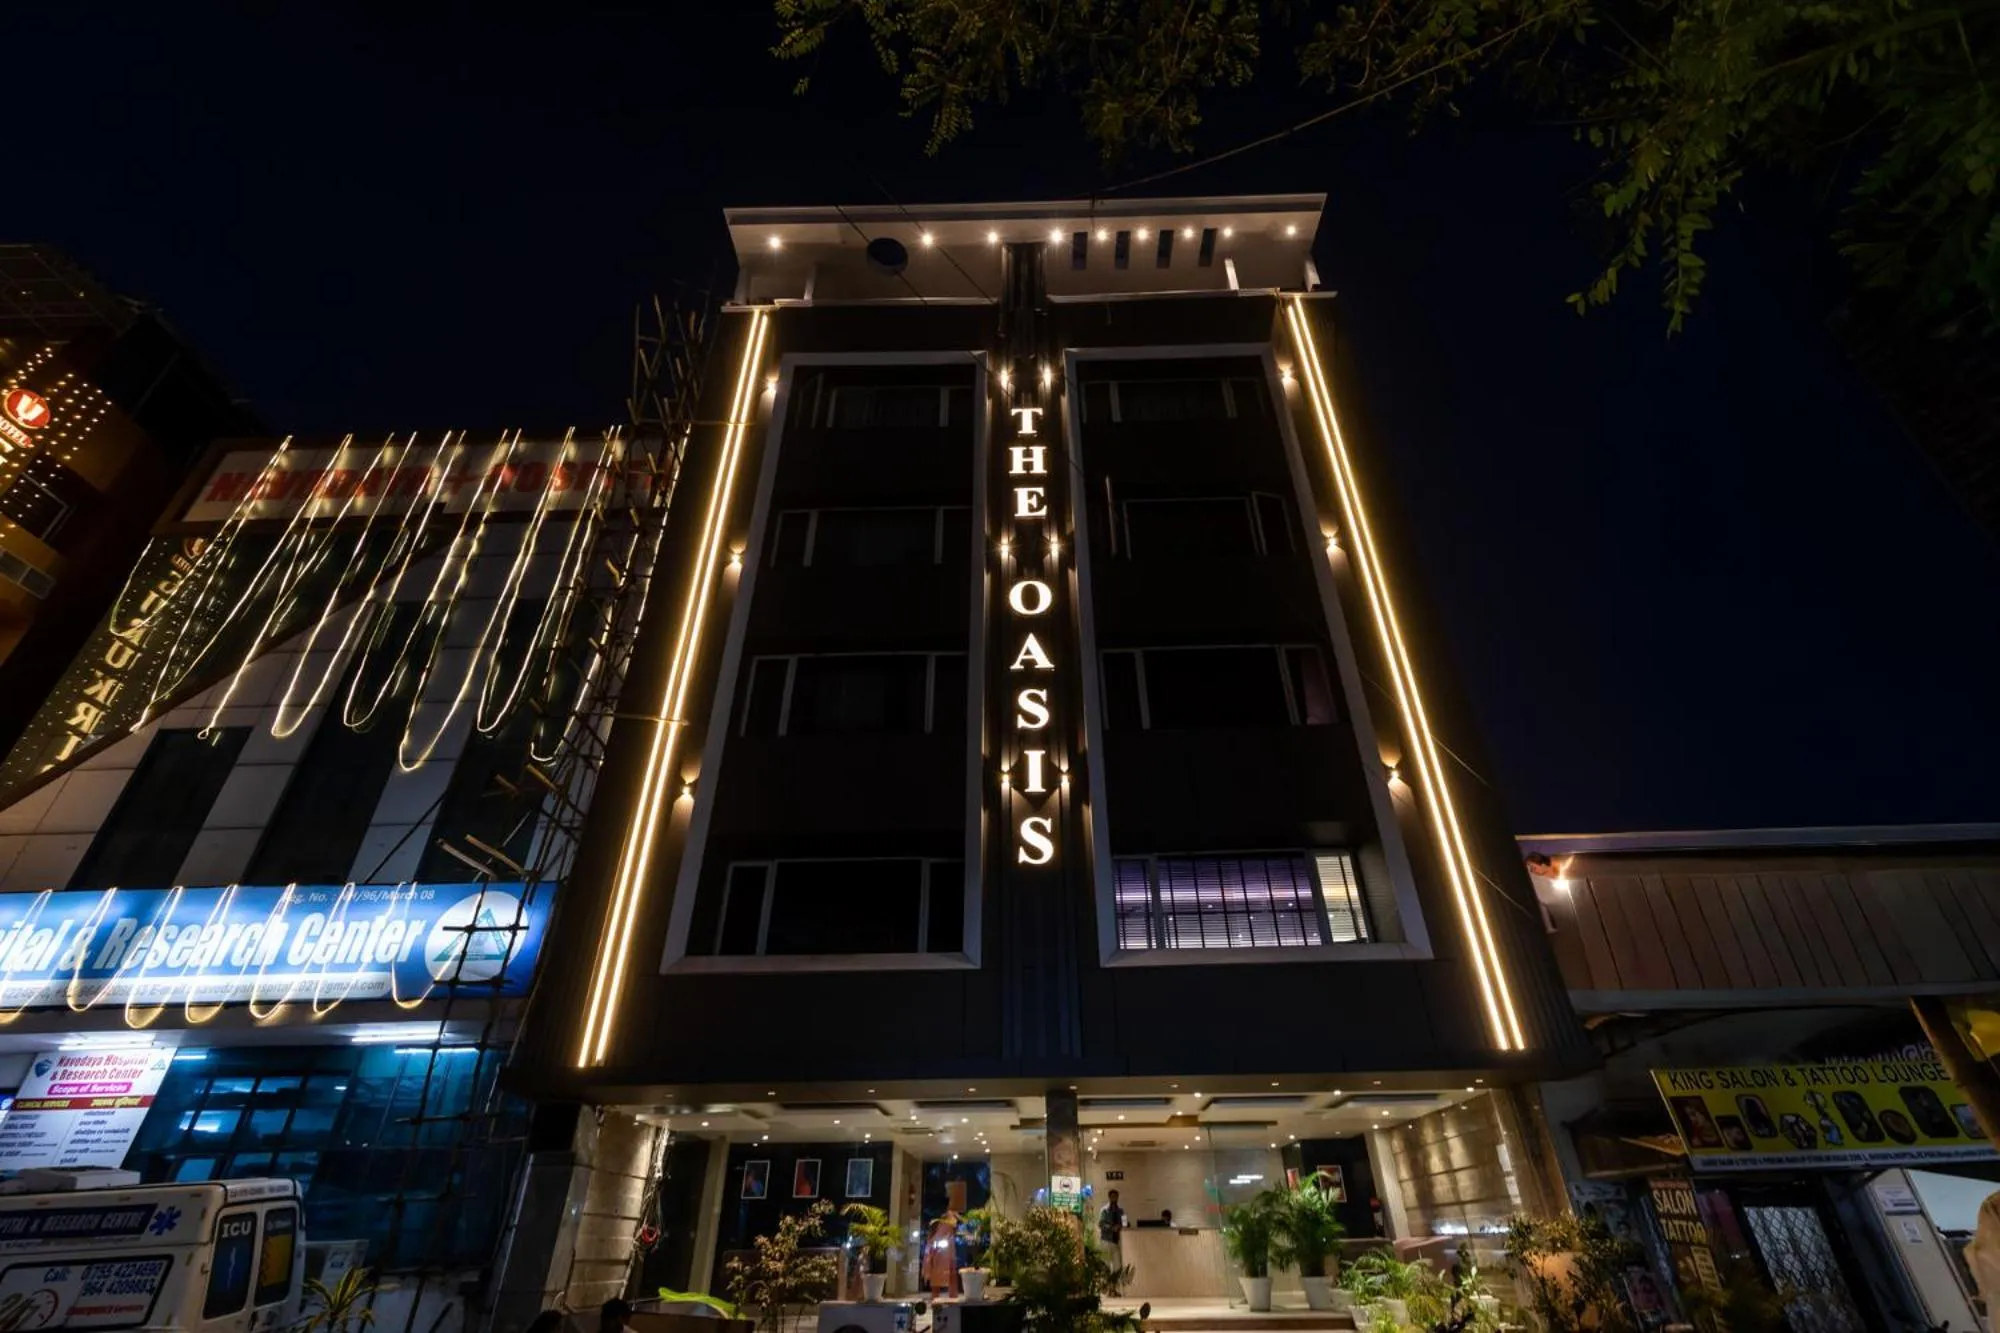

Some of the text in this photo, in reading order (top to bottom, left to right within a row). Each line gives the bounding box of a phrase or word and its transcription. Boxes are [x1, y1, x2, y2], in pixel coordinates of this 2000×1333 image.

[1009, 407, 1055, 865] THE OASIS
[58, 925, 96, 971] &
[93, 915, 290, 970] Research
[287, 911, 427, 966] Center
[59, 1068, 107, 1080] Research
[108, 1067, 144, 1079] Center
[1668, 1061, 1951, 1091] KING SALON & TATTOO LOUNGE
[1652, 1188, 1698, 1217] SALON
[221, 1220, 252, 1238] ICU
[1660, 1218, 1708, 1246] TATTOO
